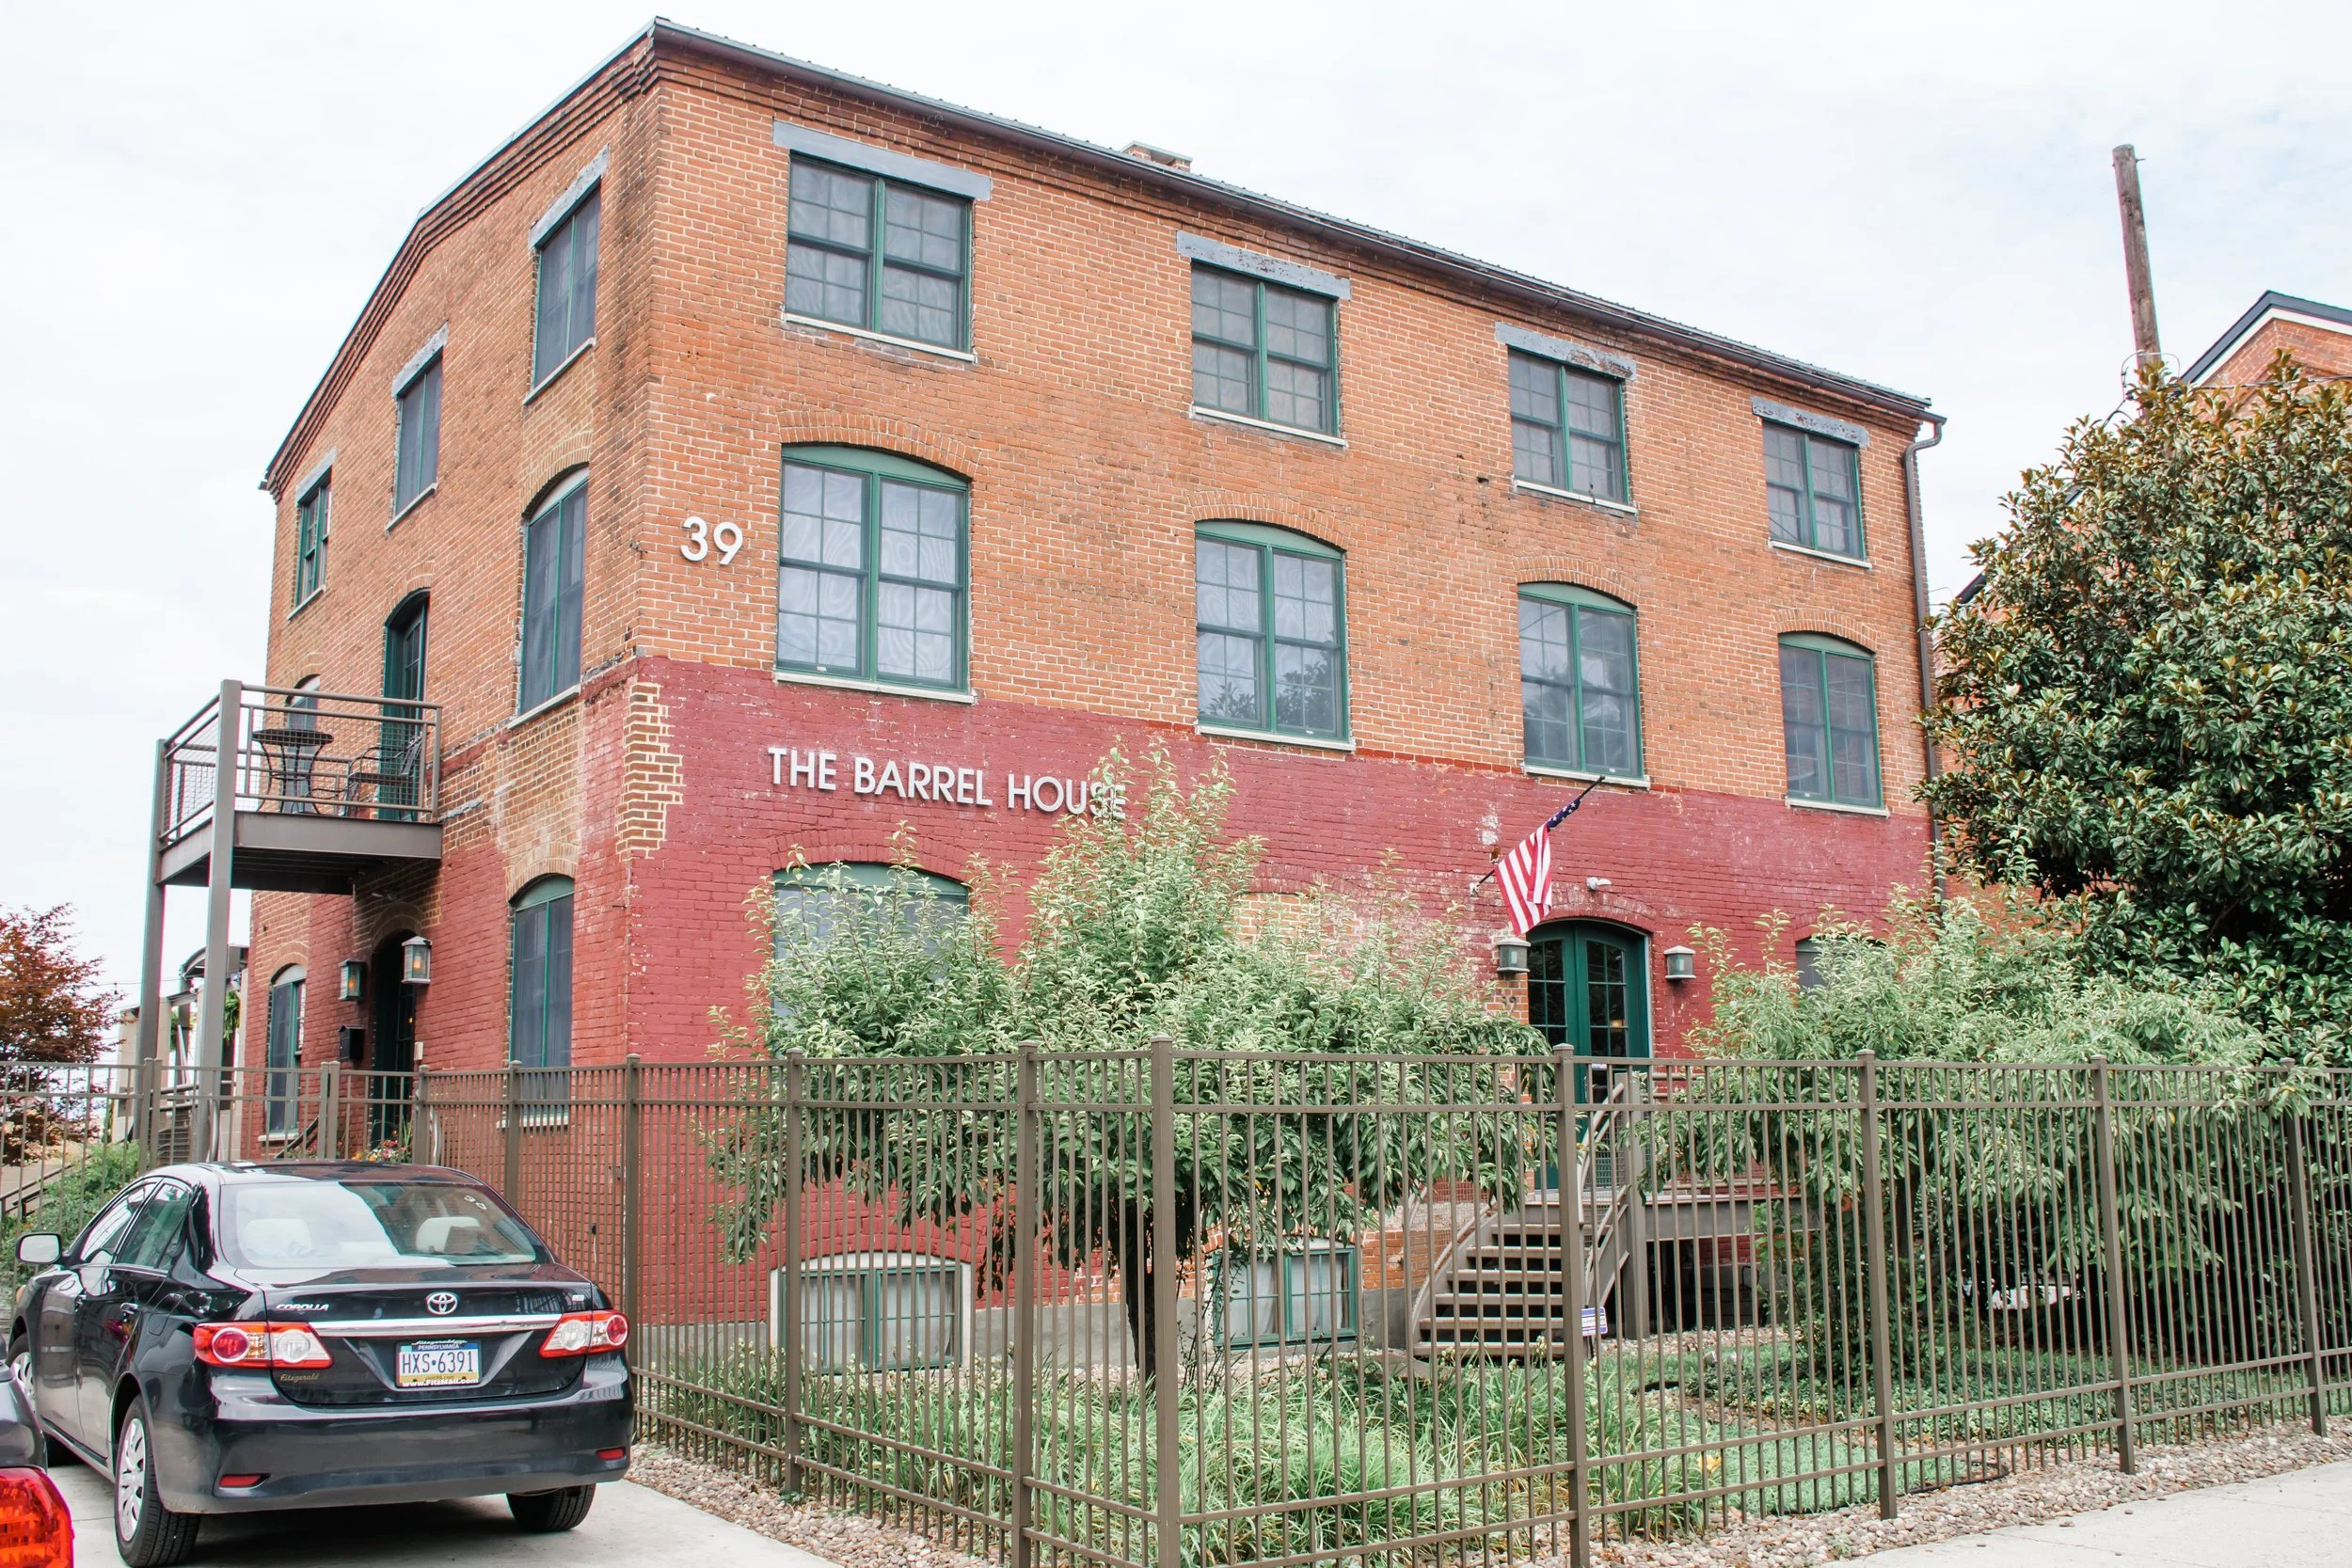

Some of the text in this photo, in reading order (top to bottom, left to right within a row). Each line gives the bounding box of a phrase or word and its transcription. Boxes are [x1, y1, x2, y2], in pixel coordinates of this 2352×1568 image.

[680, 516, 743, 565] 39
[768, 747, 837, 791] THE
[853, 756, 993, 806] BARREL
